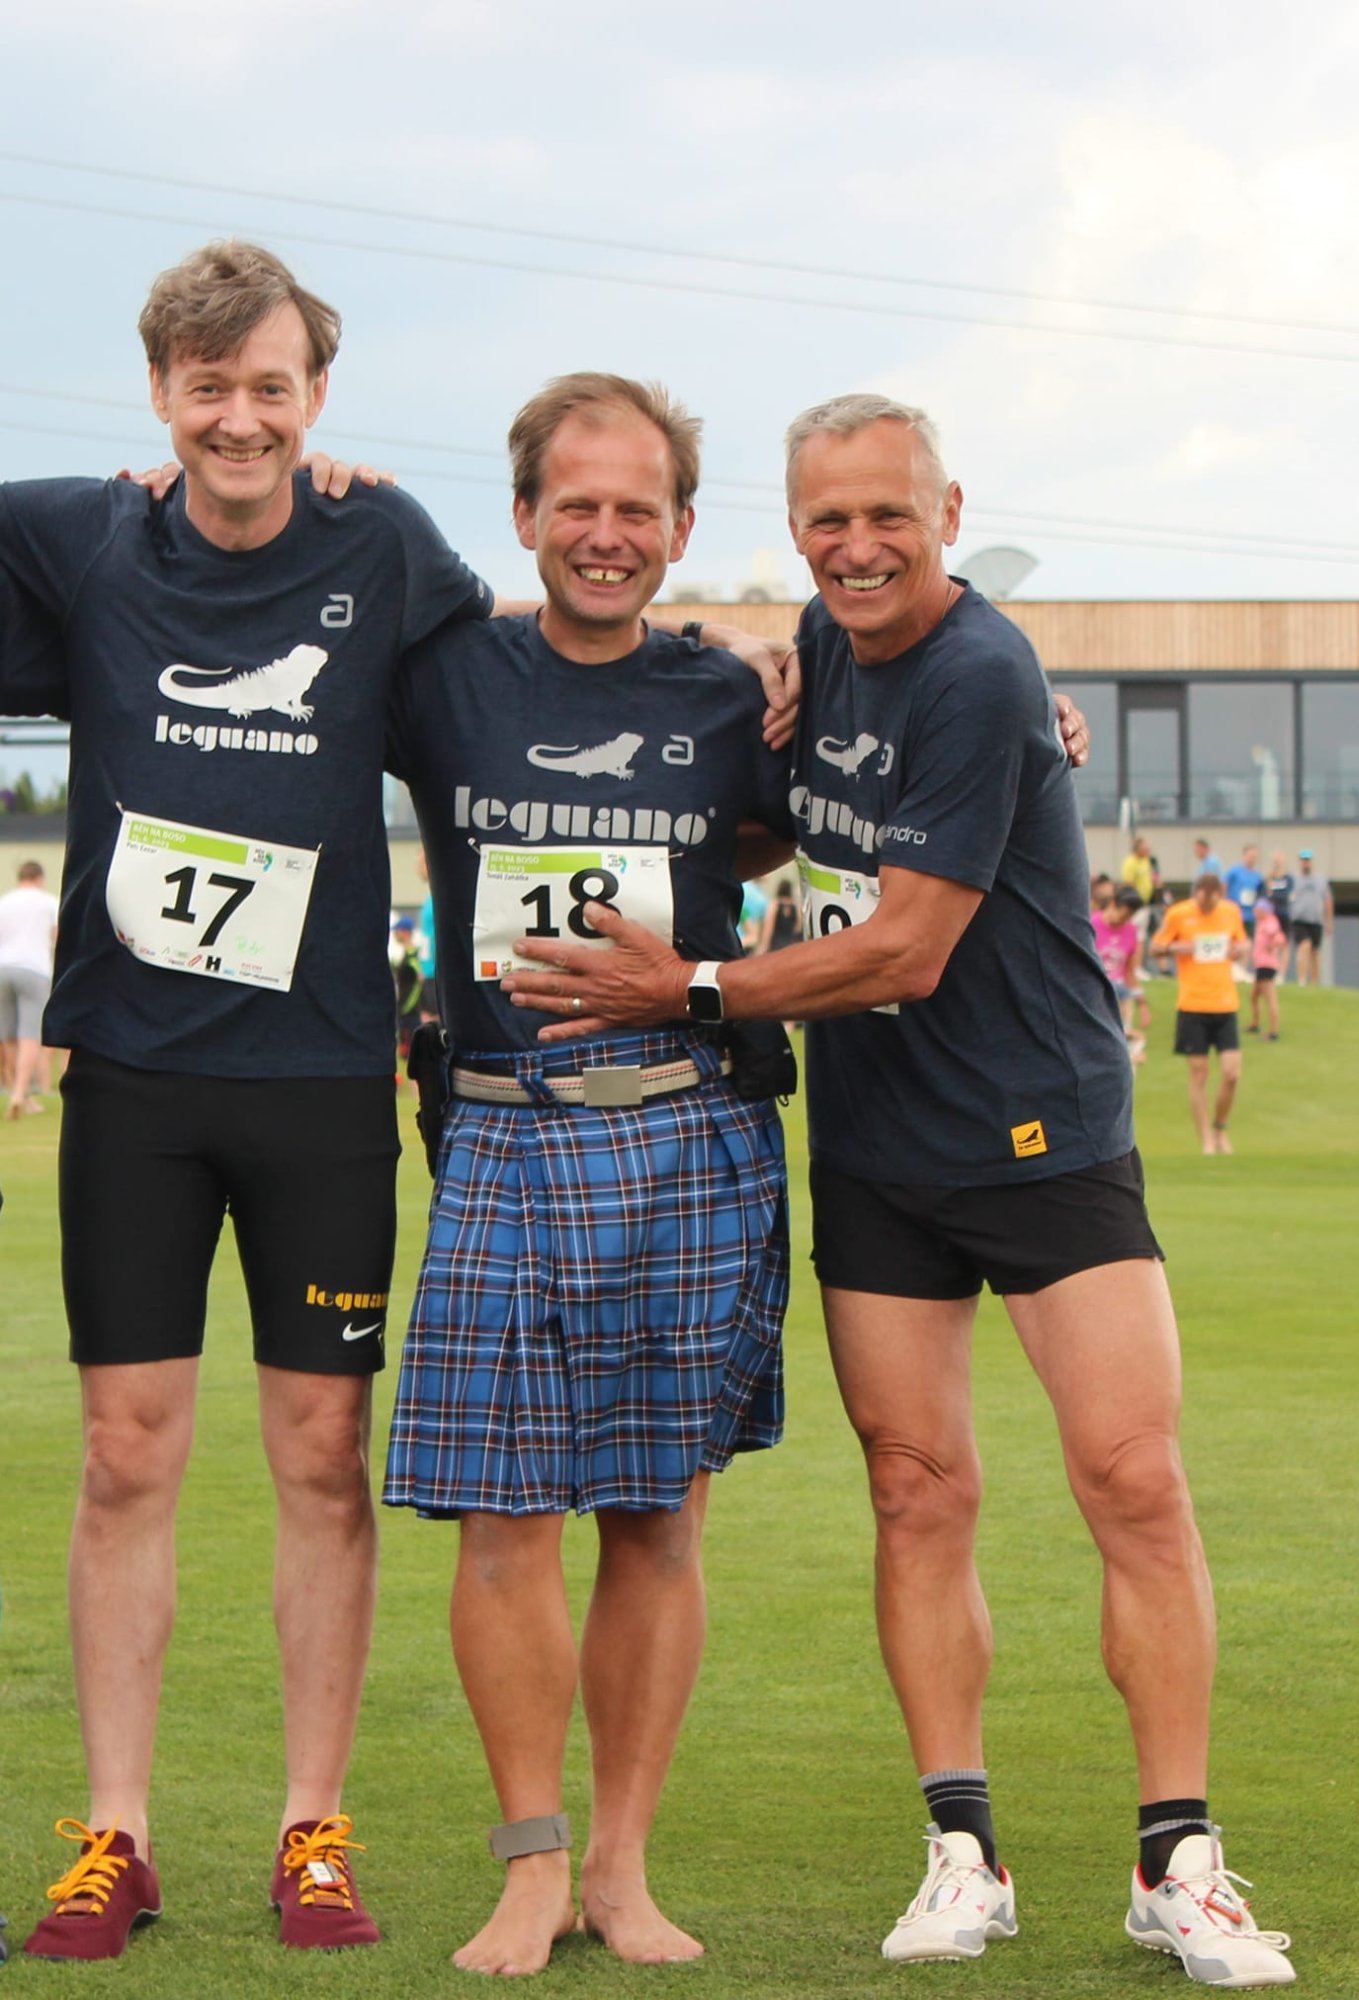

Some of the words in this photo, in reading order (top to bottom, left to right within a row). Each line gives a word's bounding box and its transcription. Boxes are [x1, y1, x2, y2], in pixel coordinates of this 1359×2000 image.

[155, 715, 318, 755] leguano
[455, 786, 708, 846] leguano
[160, 865, 256, 947] 17
[520, 868, 622, 940] 18
